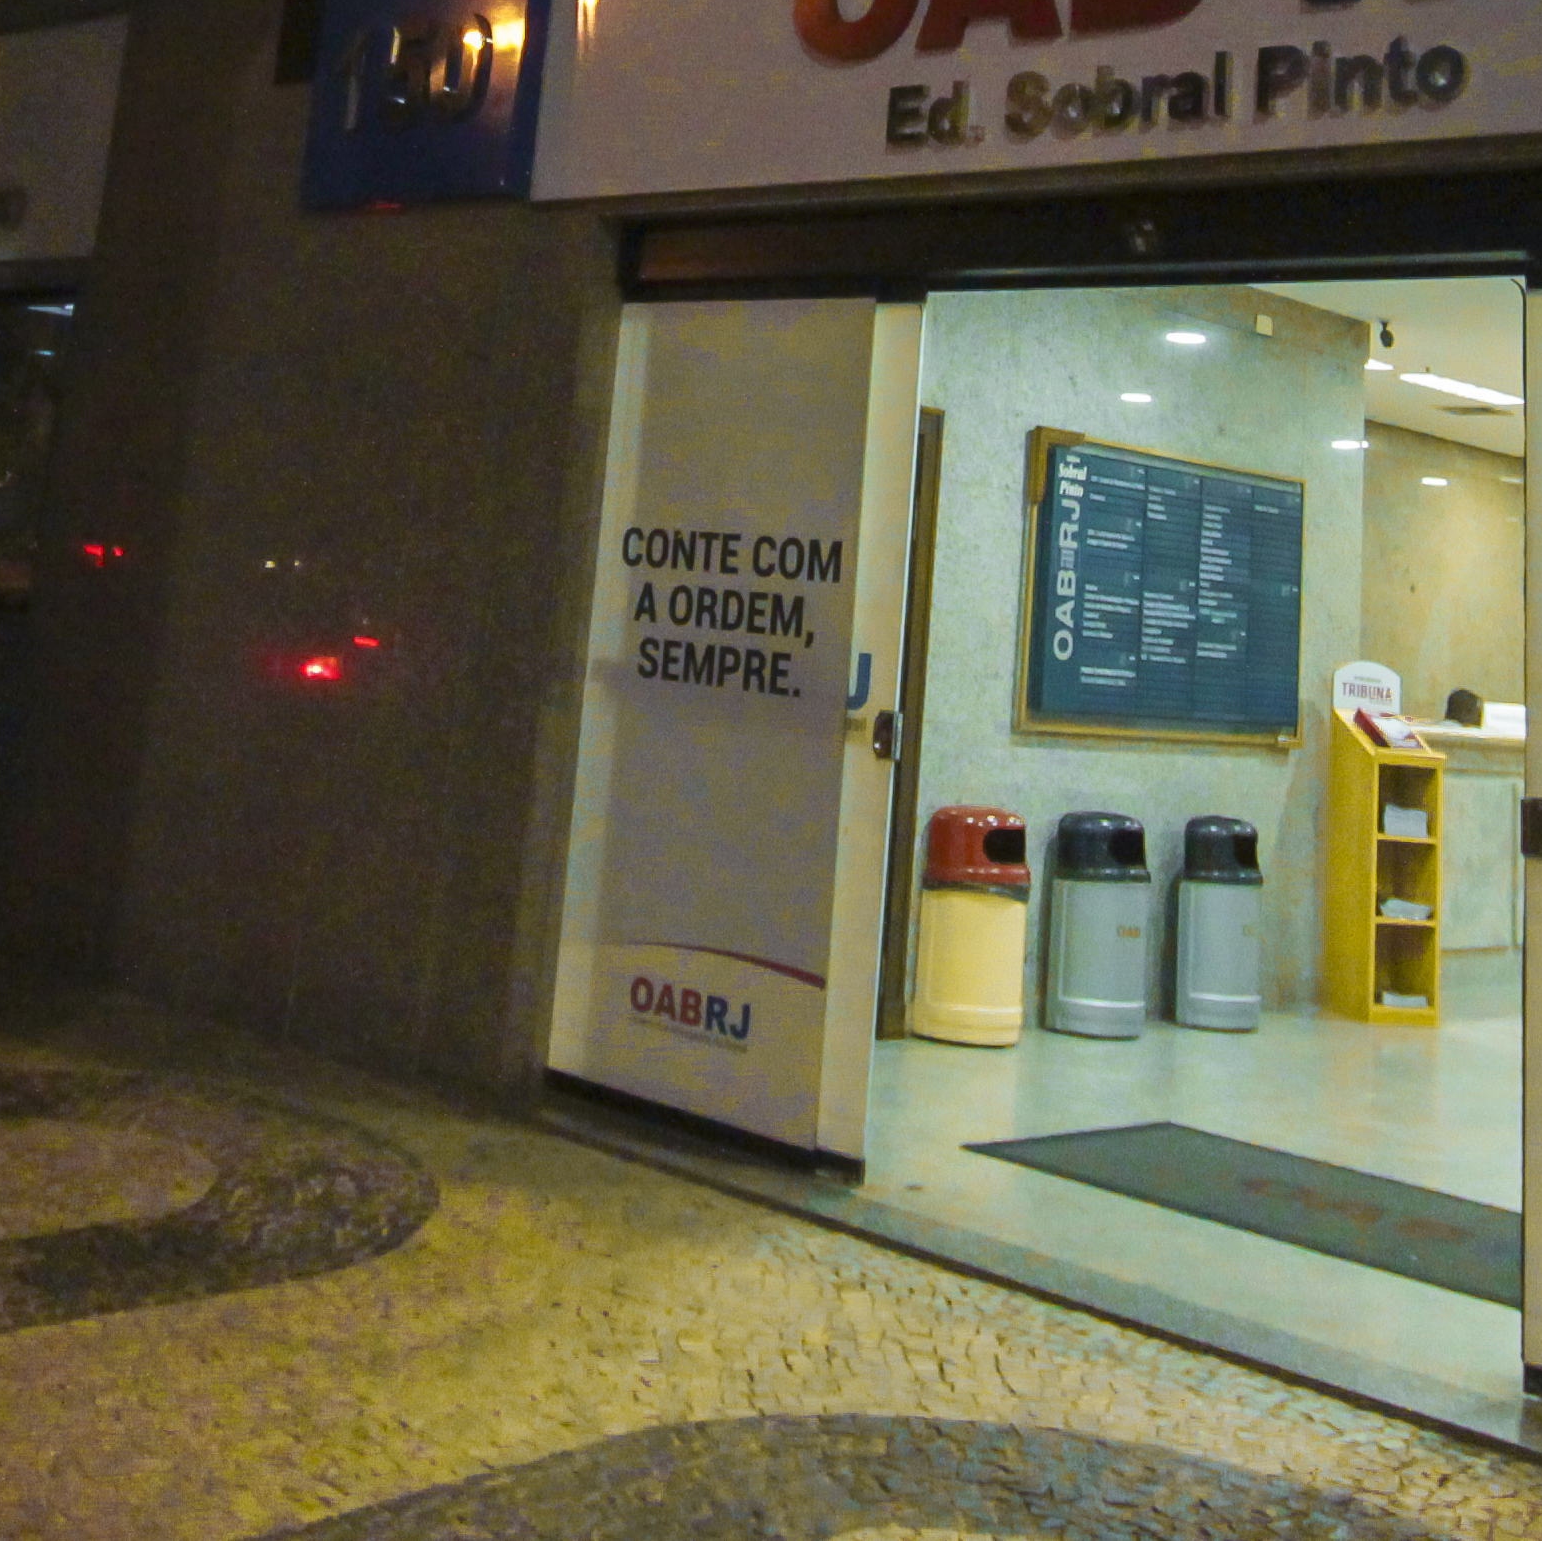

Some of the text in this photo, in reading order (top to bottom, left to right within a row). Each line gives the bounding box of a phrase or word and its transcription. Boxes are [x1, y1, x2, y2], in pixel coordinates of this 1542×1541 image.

[886, 36, 1469, 150] Ed. Sobral Pinto
[622, 527, 842, 584] CONTE COM
[633, 582, 814, 648] A ORDEM,
[637, 637, 801, 698] SEMPRE.
[1342, 682, 1393, 701] TRIBUNA
[630, 977, 752, 1040] OABRJ
